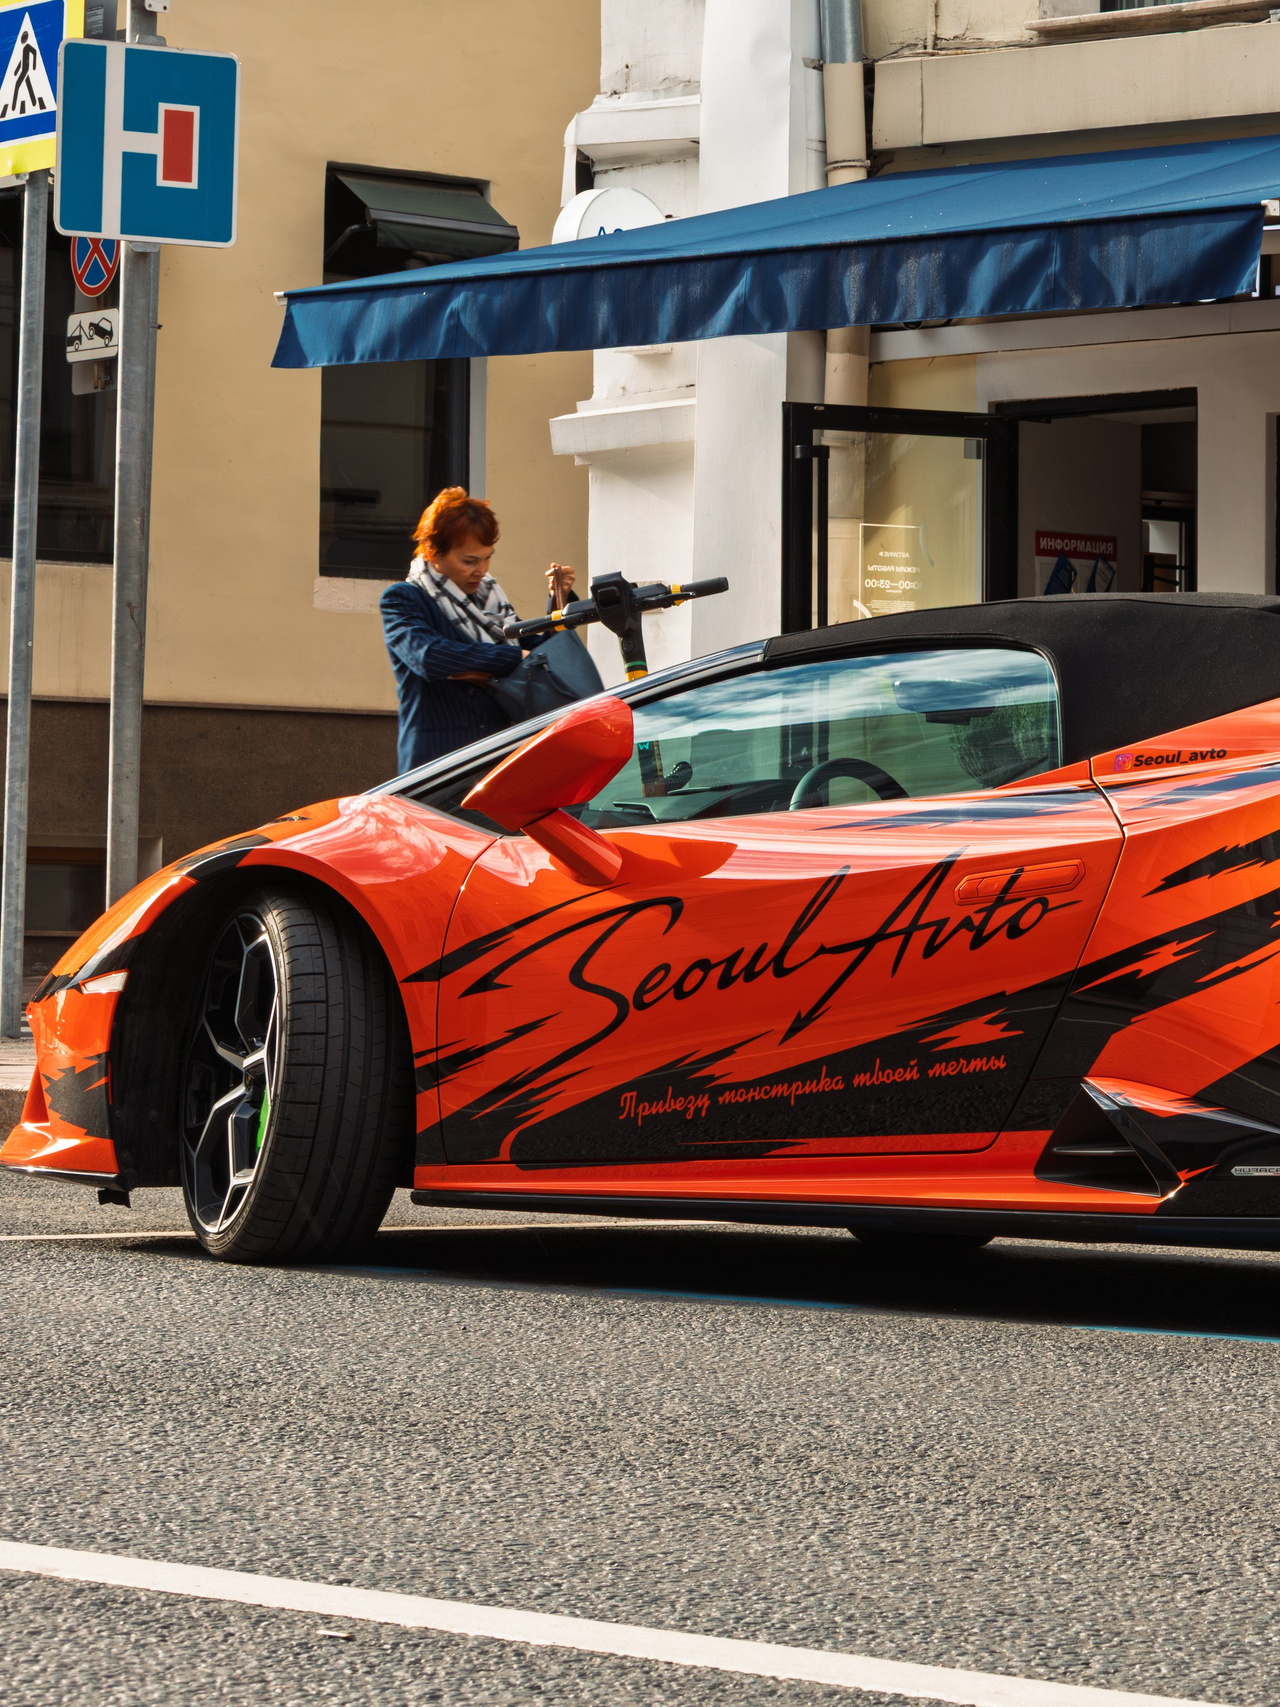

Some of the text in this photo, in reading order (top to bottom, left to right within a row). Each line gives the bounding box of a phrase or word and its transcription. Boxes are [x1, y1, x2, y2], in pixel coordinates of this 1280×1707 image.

[1040, 537, 1114, 555] ИНФОРМАЦИЯ
[1133, 748, 1227, 767] Seoul_avto
[540, 865, 852, 1045] Seoul
[618, 1055, 1007, 1127] Привезу монстрика твоей мечты
